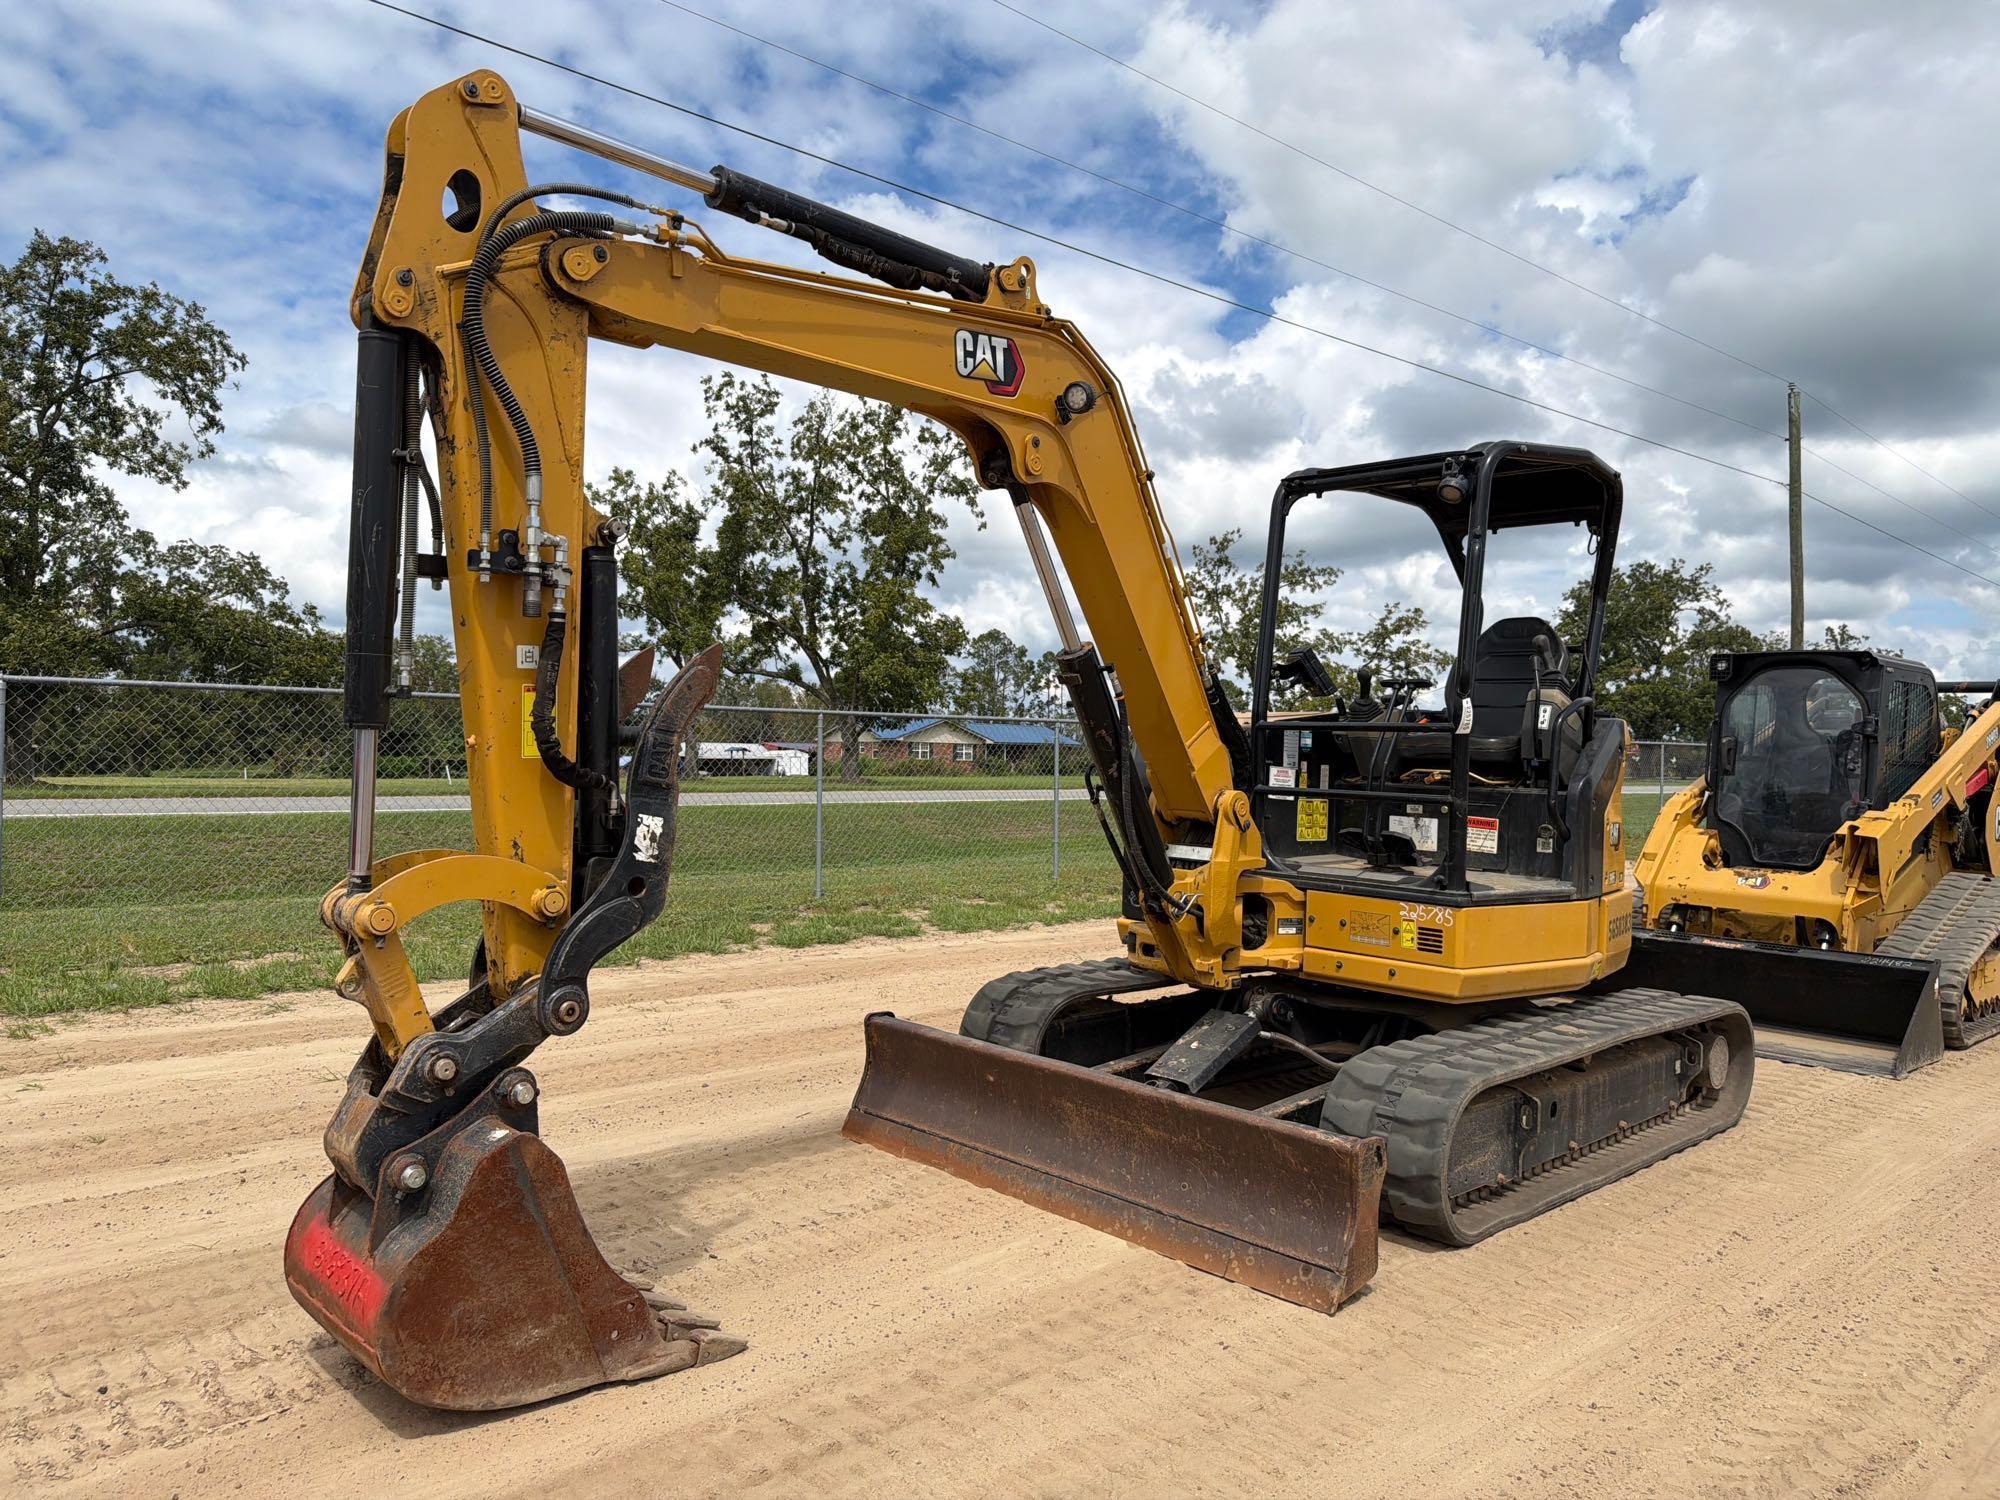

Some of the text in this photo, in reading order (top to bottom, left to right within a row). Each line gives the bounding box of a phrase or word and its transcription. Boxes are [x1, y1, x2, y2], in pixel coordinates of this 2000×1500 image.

[955, 329, 1008, 382] CAT
[648, 737, 674, 779] CAT
[1399, 902, 1454, 927] 225785
